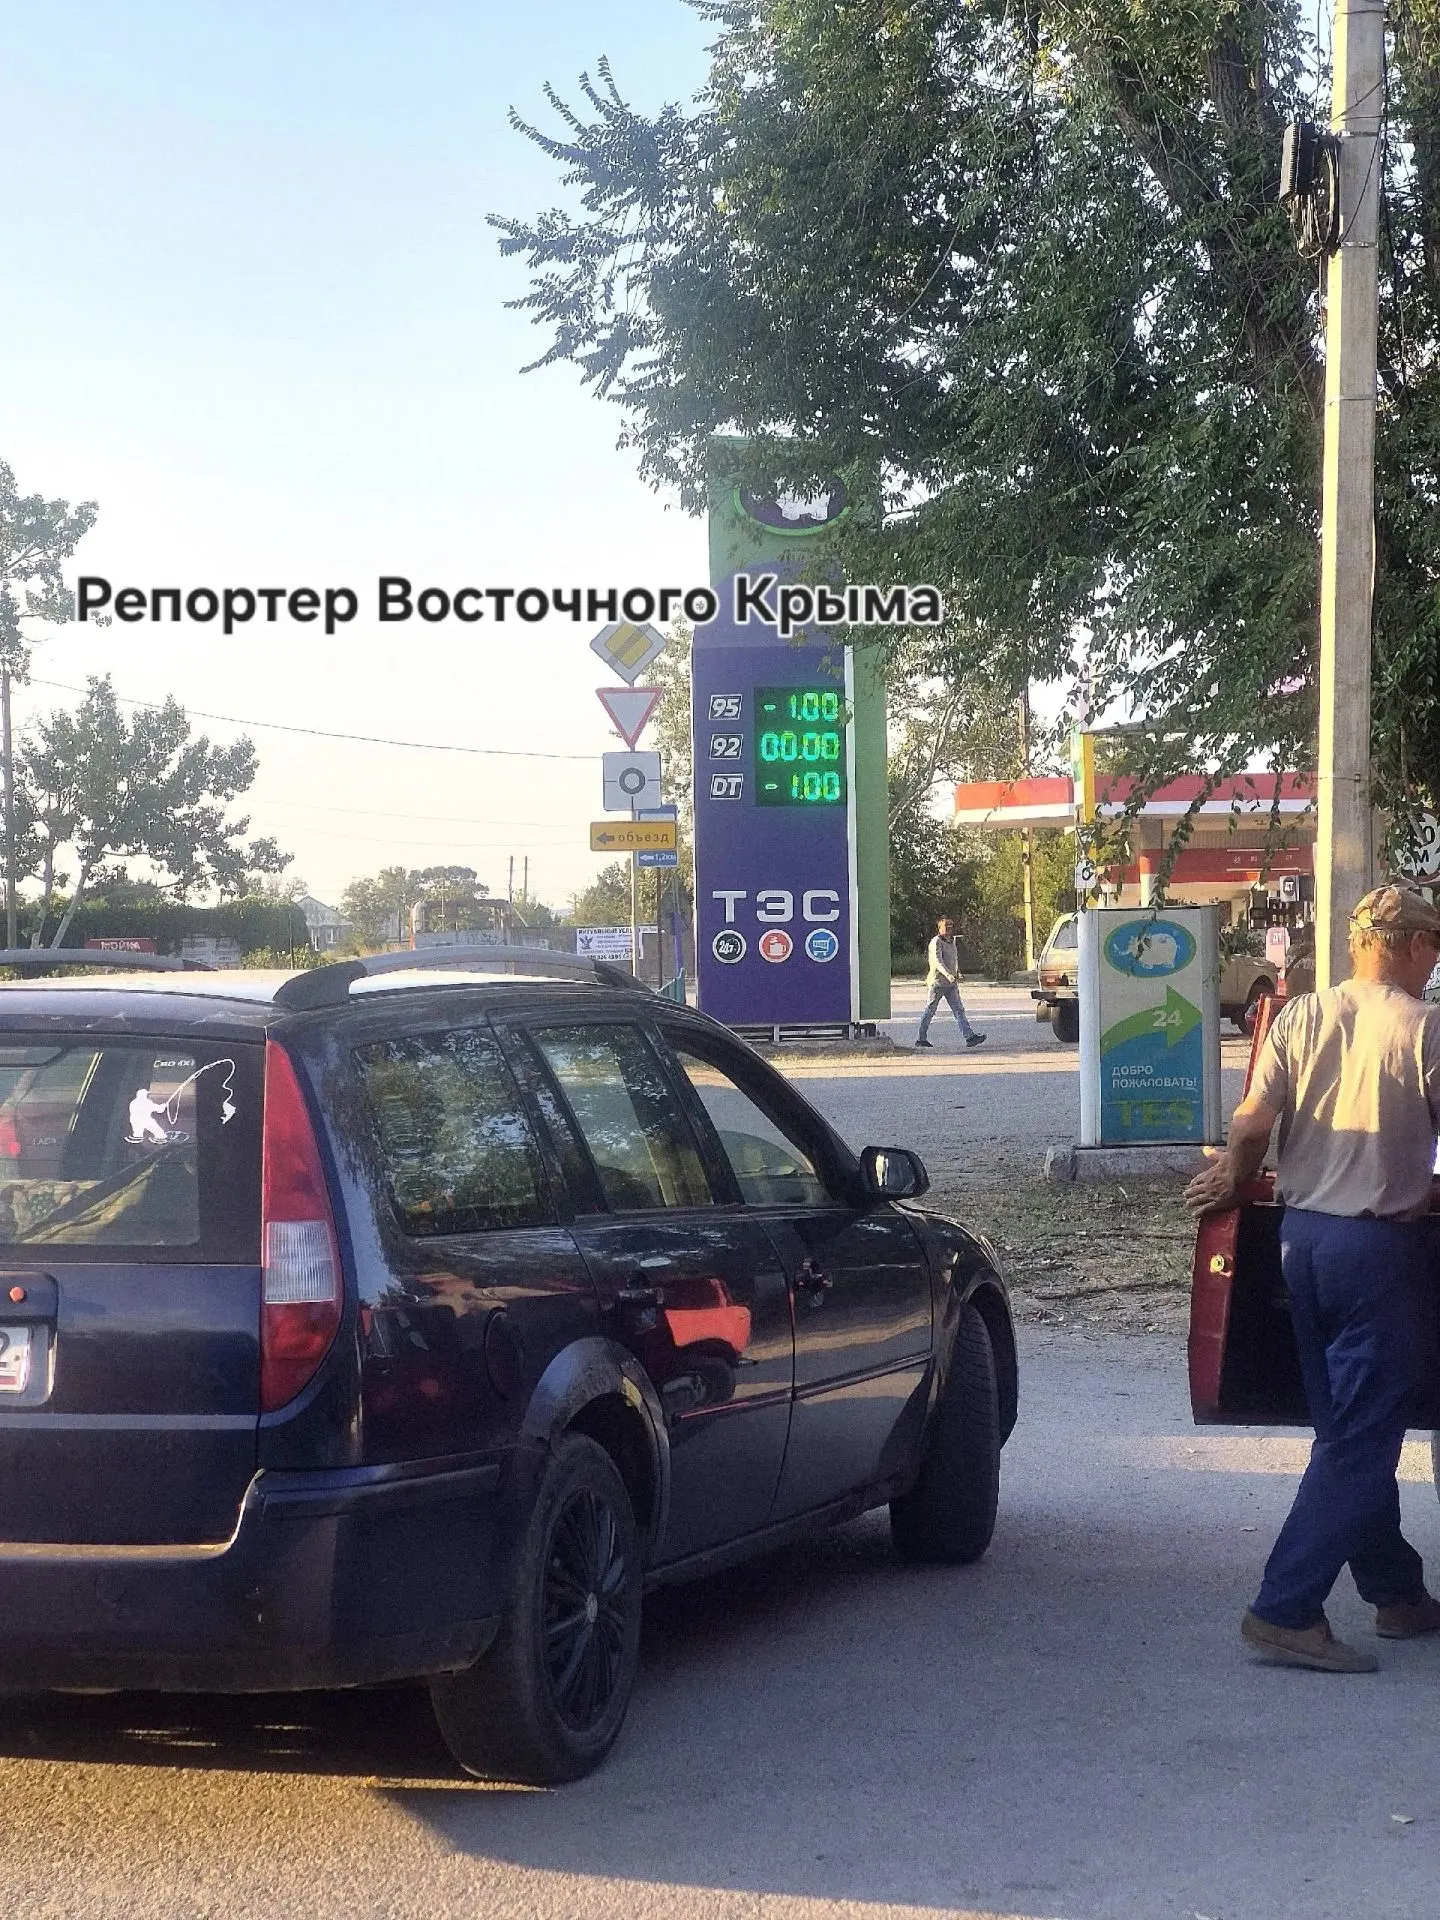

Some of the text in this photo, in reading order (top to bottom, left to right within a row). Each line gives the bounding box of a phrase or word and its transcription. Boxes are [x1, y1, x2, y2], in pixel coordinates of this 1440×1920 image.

[712, 698, 739, 717] 95
[713, 737, 740, 756] 92
[761, 731, 840, 761] 00.00
[618, 830, 669, 844] объезд
[712, 889, 840, 922] ТЭС
[1152, 1010, 1183, 1027] 24
[1112, 1065, 1154, 1078] ДОБРО
[1112, 1077, 1198, 1089] ПОЖАЛОВАТЬ!
[1116, 1099, 1195, 1127] TES
